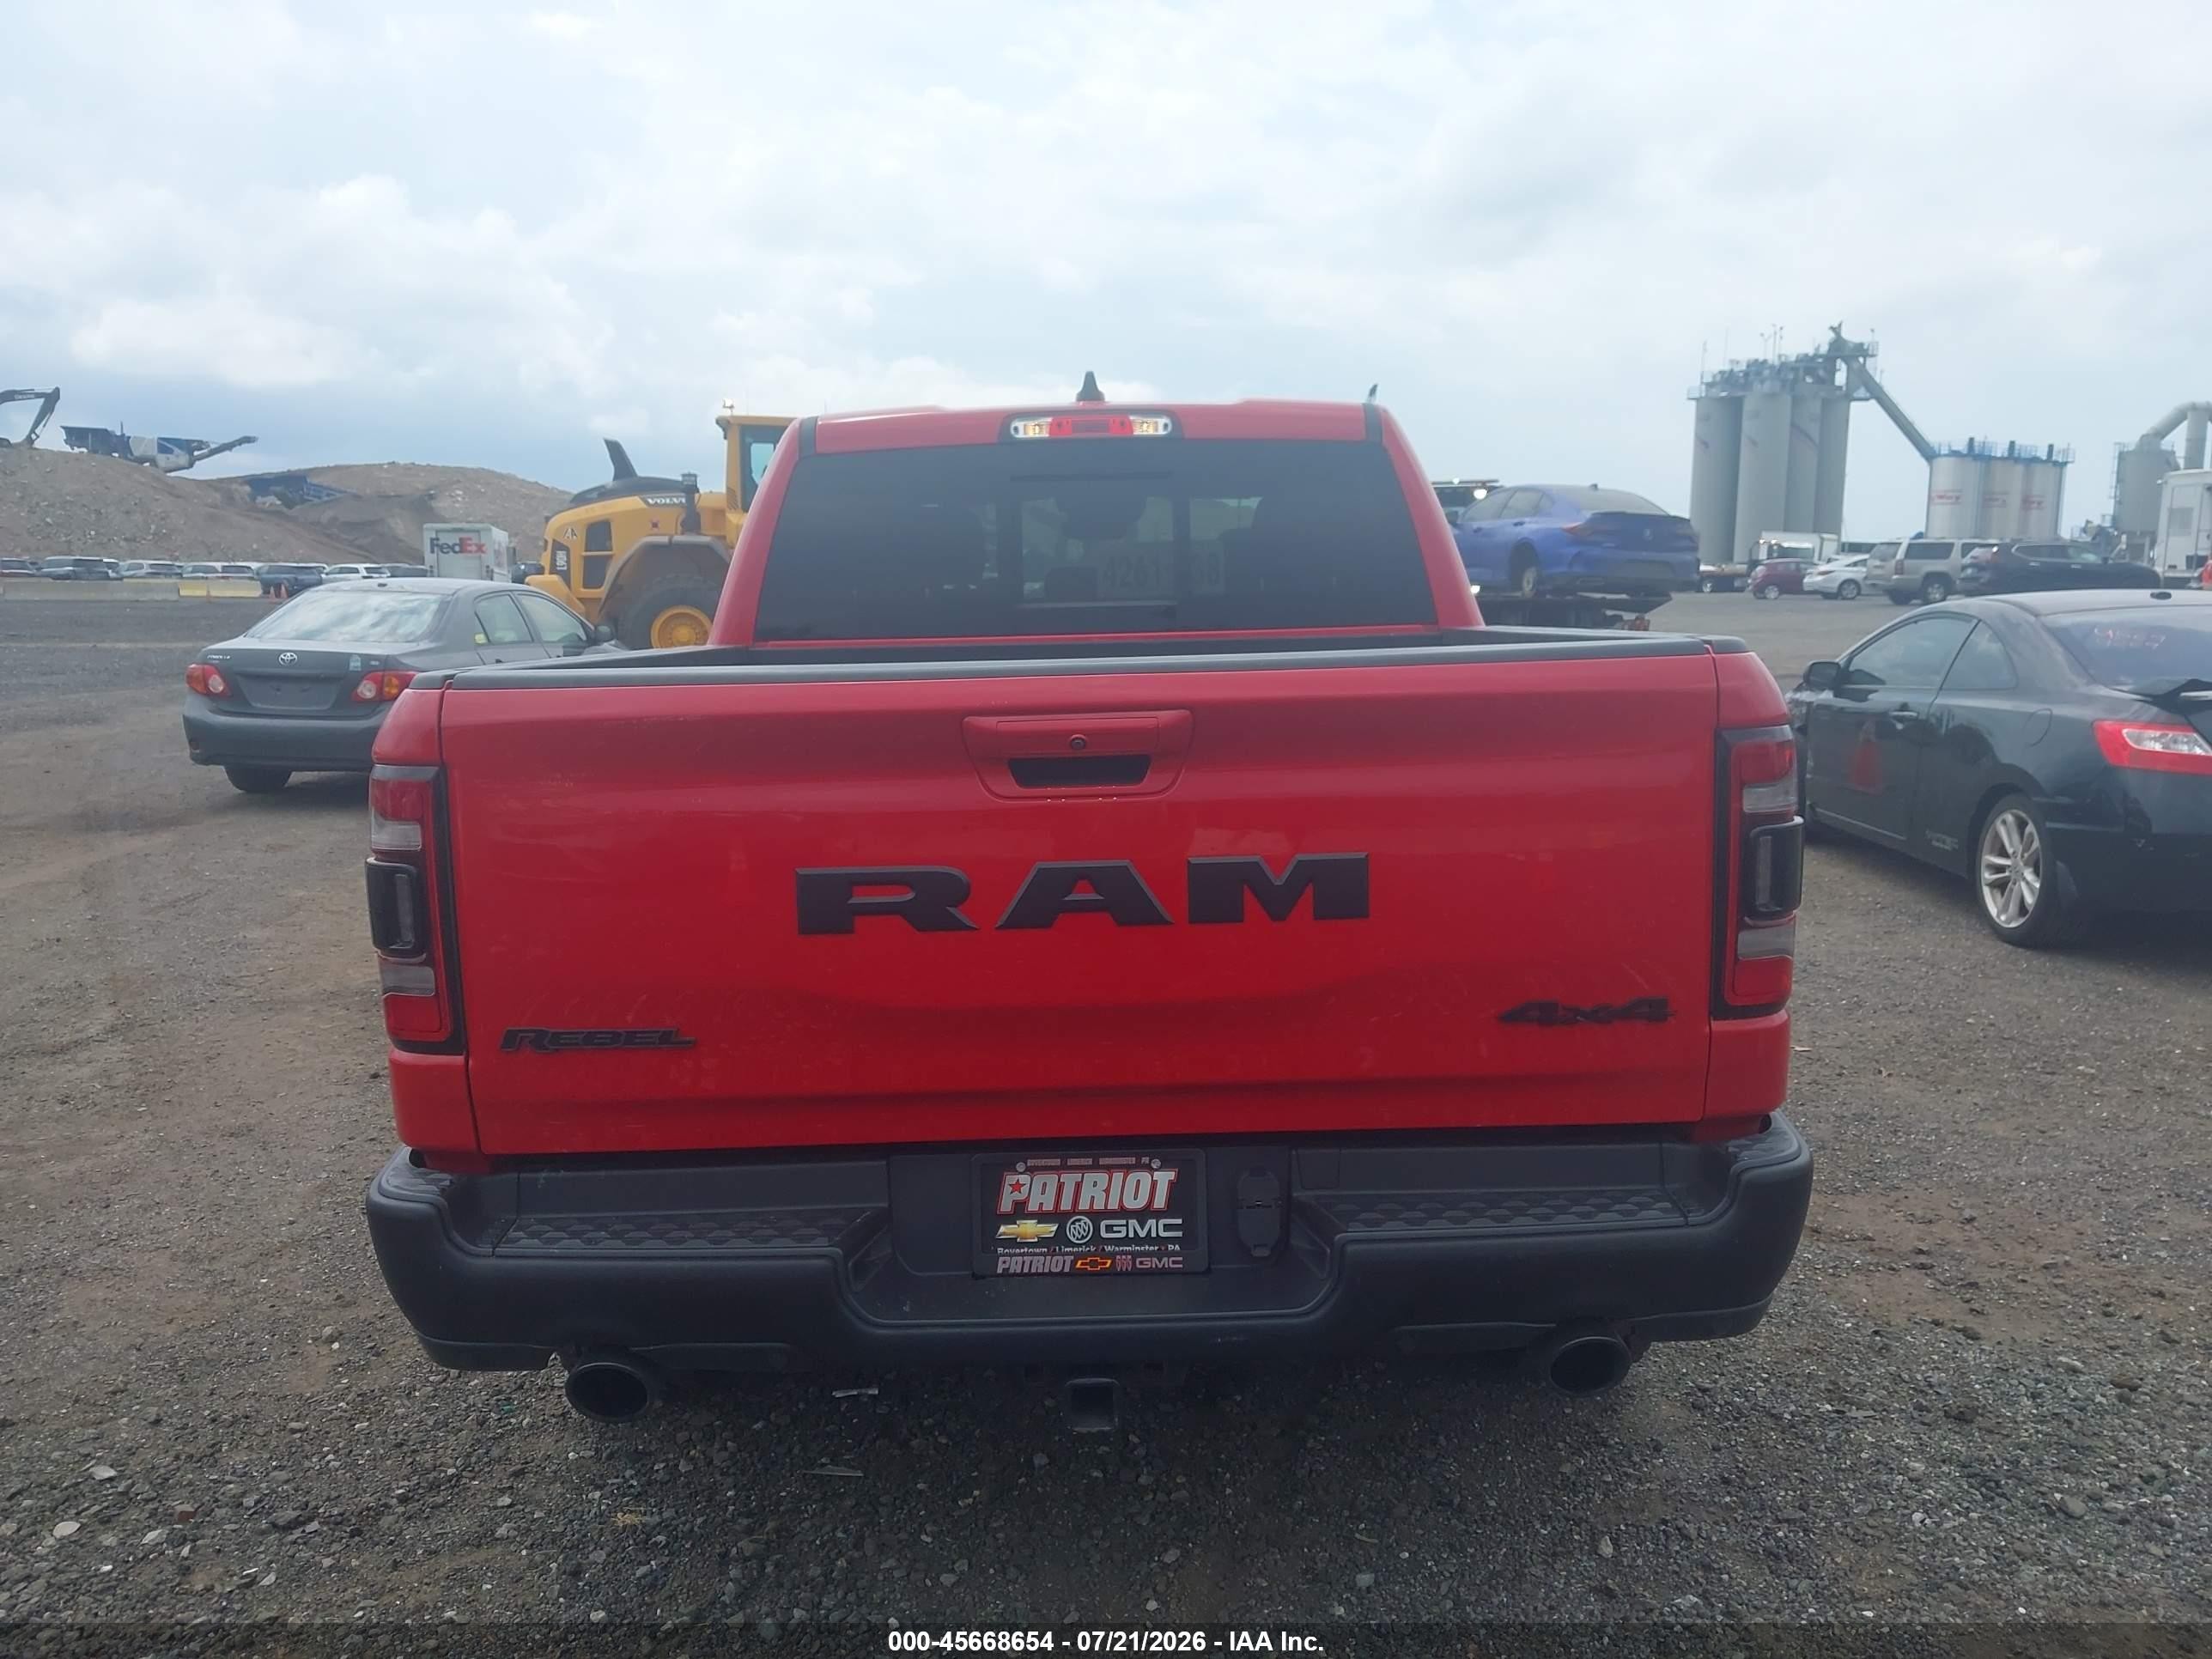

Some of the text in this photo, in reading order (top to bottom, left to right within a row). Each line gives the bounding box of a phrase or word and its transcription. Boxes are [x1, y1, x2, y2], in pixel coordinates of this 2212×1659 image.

[429, 536, 487, 555] FedEx
[795, 852, 1369, 935] RAM
[997, 1169, 1178, 1213] PATRIOT
[1100, 1218, 1183, 1239] GMC
[997, 1255, 1183, 1273] PATRIOT GMC
